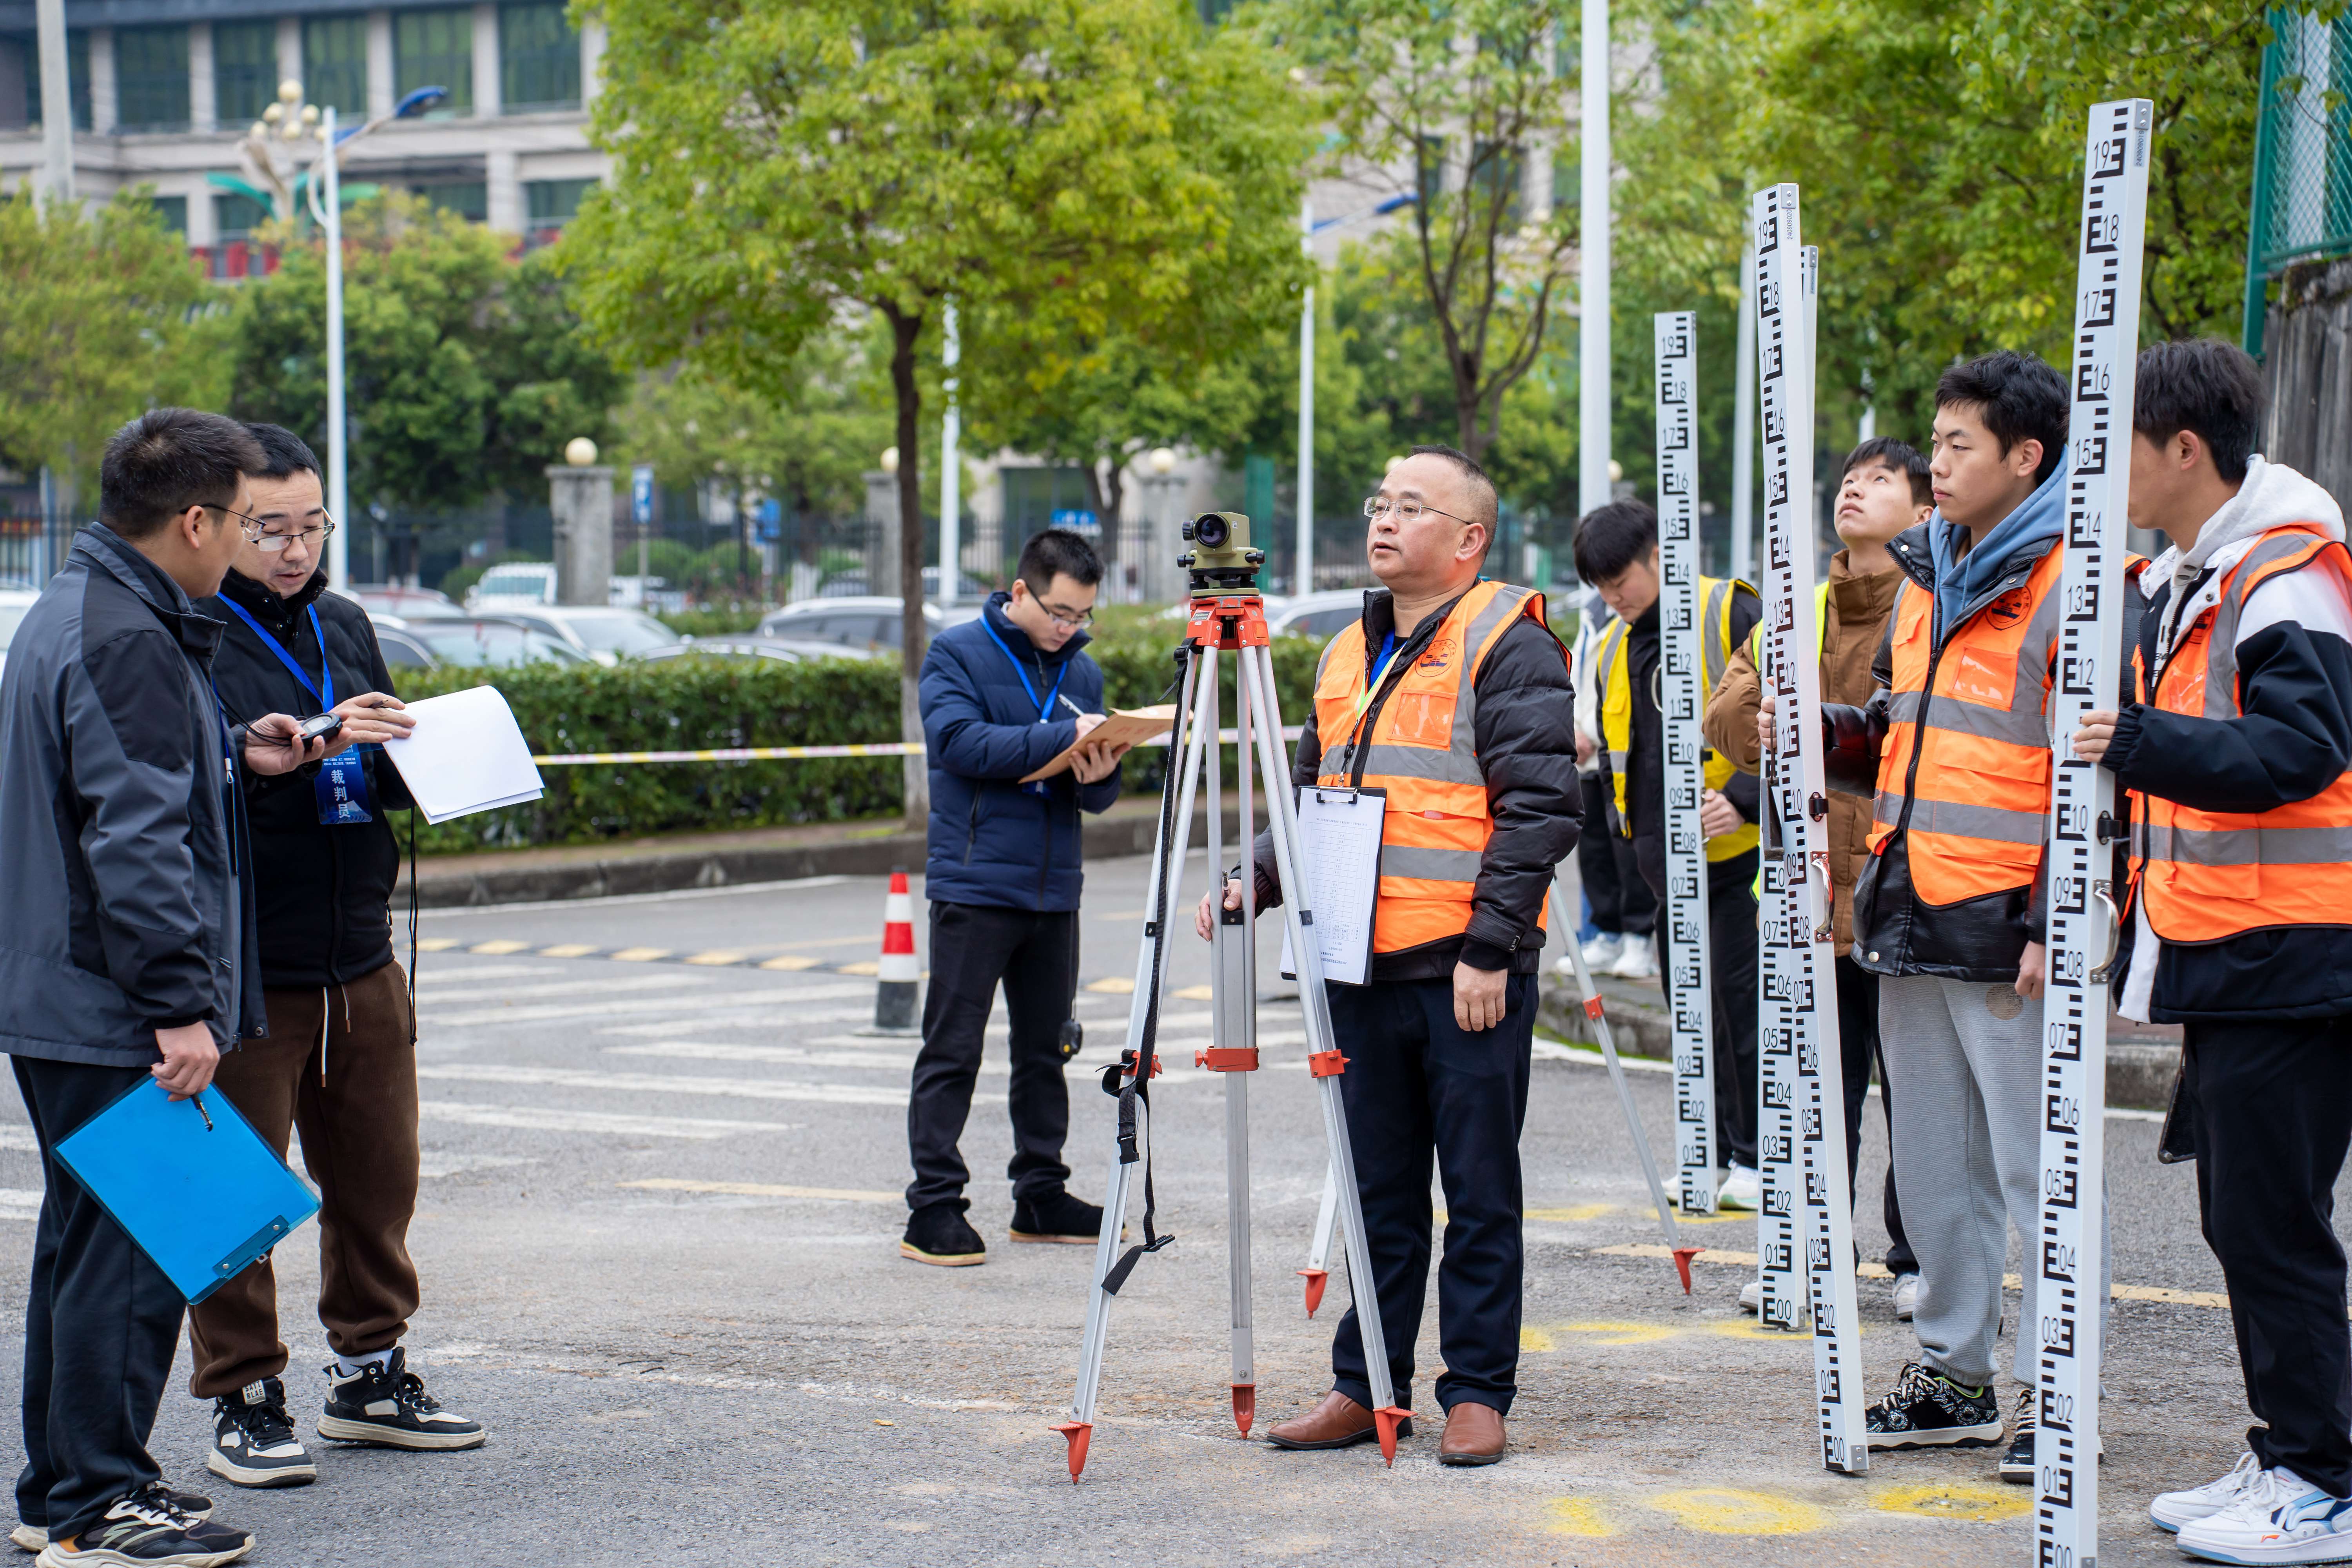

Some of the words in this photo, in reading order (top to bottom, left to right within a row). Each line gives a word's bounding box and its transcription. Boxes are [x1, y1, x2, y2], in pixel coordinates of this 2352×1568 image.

[2094, 140, 2109, 170] 19
[2136, 130, 2145, 166] 240909019
[1759, 221, 1768, 246] 19
[2103, 214, 2119, 243] 18
[1769, 282, 1779, 307] 18
[2084, 290, 2100, 318] 17
[1662, 336, 1674, 353] 19
[1763, 348, 1772, 374] 17
[2094, 363, 2110, 391] 16
[1674, 381, 1687, 399] 18
[1774, 408, 1784, 433] 16
[1663, 428, 1675, 445] 17
[2076, 439, 2091, 466] 15
[1676, 473, 1688, 490] 16
[1768, 474, 1778, 499] 15
[1665, 518, 1677, 535] 15
[2085, 512, 2102, 539] 14
[1779, 535, 1790, 559] 14
[1677, 563, 1689, 580] 14
[2068, 586, 2083, 612] 13
[1666, 608, 1679, 626] 13
[1774, 601, 1784, 624] 13
[1679, 653, 1691, 670] 12
[2078, 658, 2094, 685] 12
[1786, 662, 1795, 686] 12
[1670, 698, 1681, 715] 11
[1782, 726, 1791, 750] 11
[2063, 732, 2077, 758] 1
[1681, 743, 1693, 760] 10
[331, 769, 350, 818] 裁判员
[1670, 788, 1682, 805] 09
[1792, 789, 1802, 813] 10
[2072, 805, 2088, 832] 10
[1683, 832, 1696, 849] 08
[1787, 853, 1797, 877] 09
[1671, 877, 1685, 894] 07
[1779, 868, 1784, 887] 0
[2054, 877, 2071, 903] 09
[1686, 922, 1699, 939] 06
[1764, 921, 1779, 940] 07
[1799, 916, 1810, 940] 08
[1675, 966, 1688, 984] 05
[2067, 951, 2083, 978] 08
[1777, 975, 1791, 995] 06
[1794, 981, 1803, 1005] 07
[1688, 1011, 1702, 1028] 04
[1764, 1028, 1778, 1048] 05
[2049, 1023, 2066, 1049] 07
[1677, 1055, 1691, 1073] 03
[1807, 1044, 1818, 1068] 06
[1777, 1083, 1791, 1102] 04
[1691, 1100, 1705, 1118] 02
[1802, 1109, 1812, 1133] 05
[2062, 1098, 2079, 1125] 06
[1682, 1144, 1695, 1162] 01
[1763, 1136, 1777, 1155] 03
[1815, 1174, 1826, 1197] 04
[2045, 1169, 2061, 1196] 05
[1695, 1190, 1708, 1207] 00
[1777, 1191, 1791, 1211] 02
[1765, 1244, 1779, 1264] 01
[1810, 1239, 1820, 1263] 03
[2059, 1245, 2076, 1274] 04
[1777, 1299, 1791, 1320] 00
[1824, 1304, 1835, 1328] 02
[2042, 1316, 2058, 1345] 03
[247, 1389, 263, 1399] RLAE
[1821, 1370, 1831, 1395] 01
[2056, 1394, 2073, 1423] 02
[1833, 1437, 1845, 1462] 00
[2043, 1465, 2057, 1494] 01
[2055, 1544, 2072, 1568] 00
